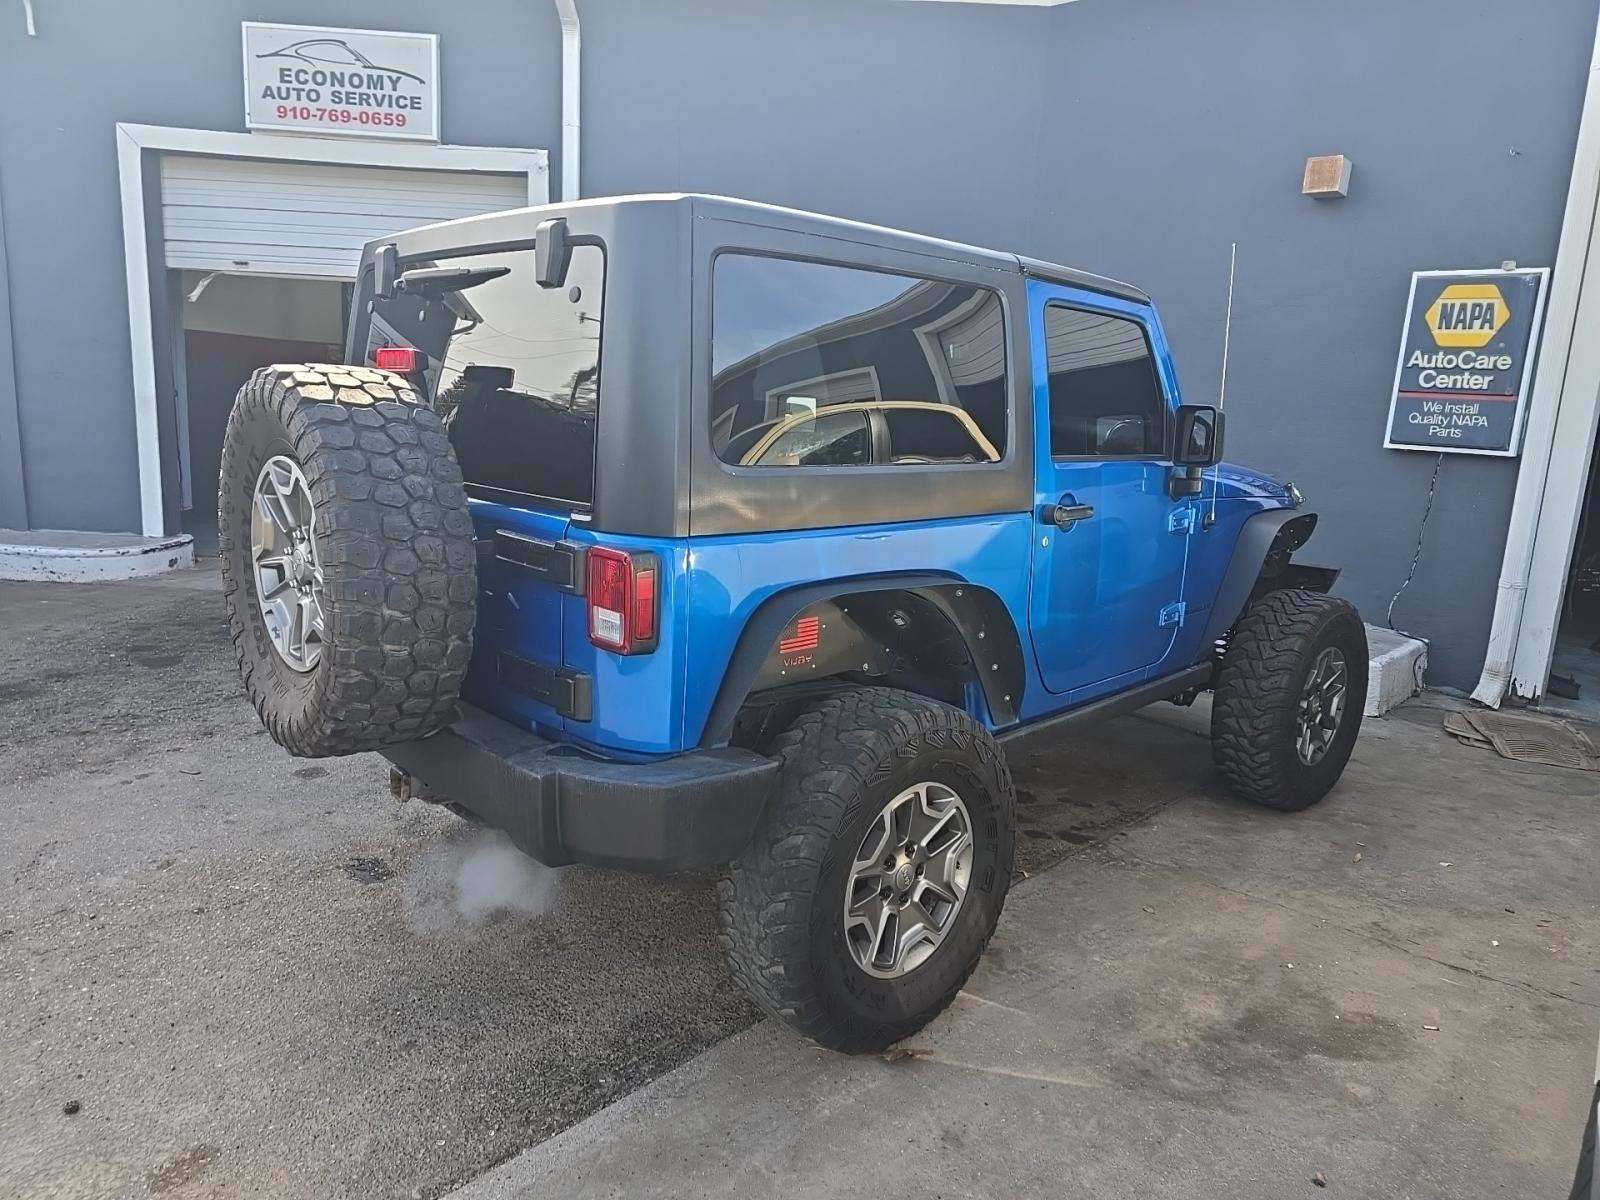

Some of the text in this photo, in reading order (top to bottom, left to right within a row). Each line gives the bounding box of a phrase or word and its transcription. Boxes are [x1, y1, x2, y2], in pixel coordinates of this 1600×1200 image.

[280, 68, 402, 91] ECONOMY
[261, 85, 422, 110] AUTO SERVICE
[276, 105, 407, 127] 910-769-0659
[1438, 303, 1495, 329] NAPA
[1406, 350, 1512, 370] AutoCare
[1418, 370, 1494, 389] Center
[1423, 401, 1480, 414] We Install
[1408, 413, 1488, 426] Quality NAPA
[1428, 426, 1462, 438] Parts
